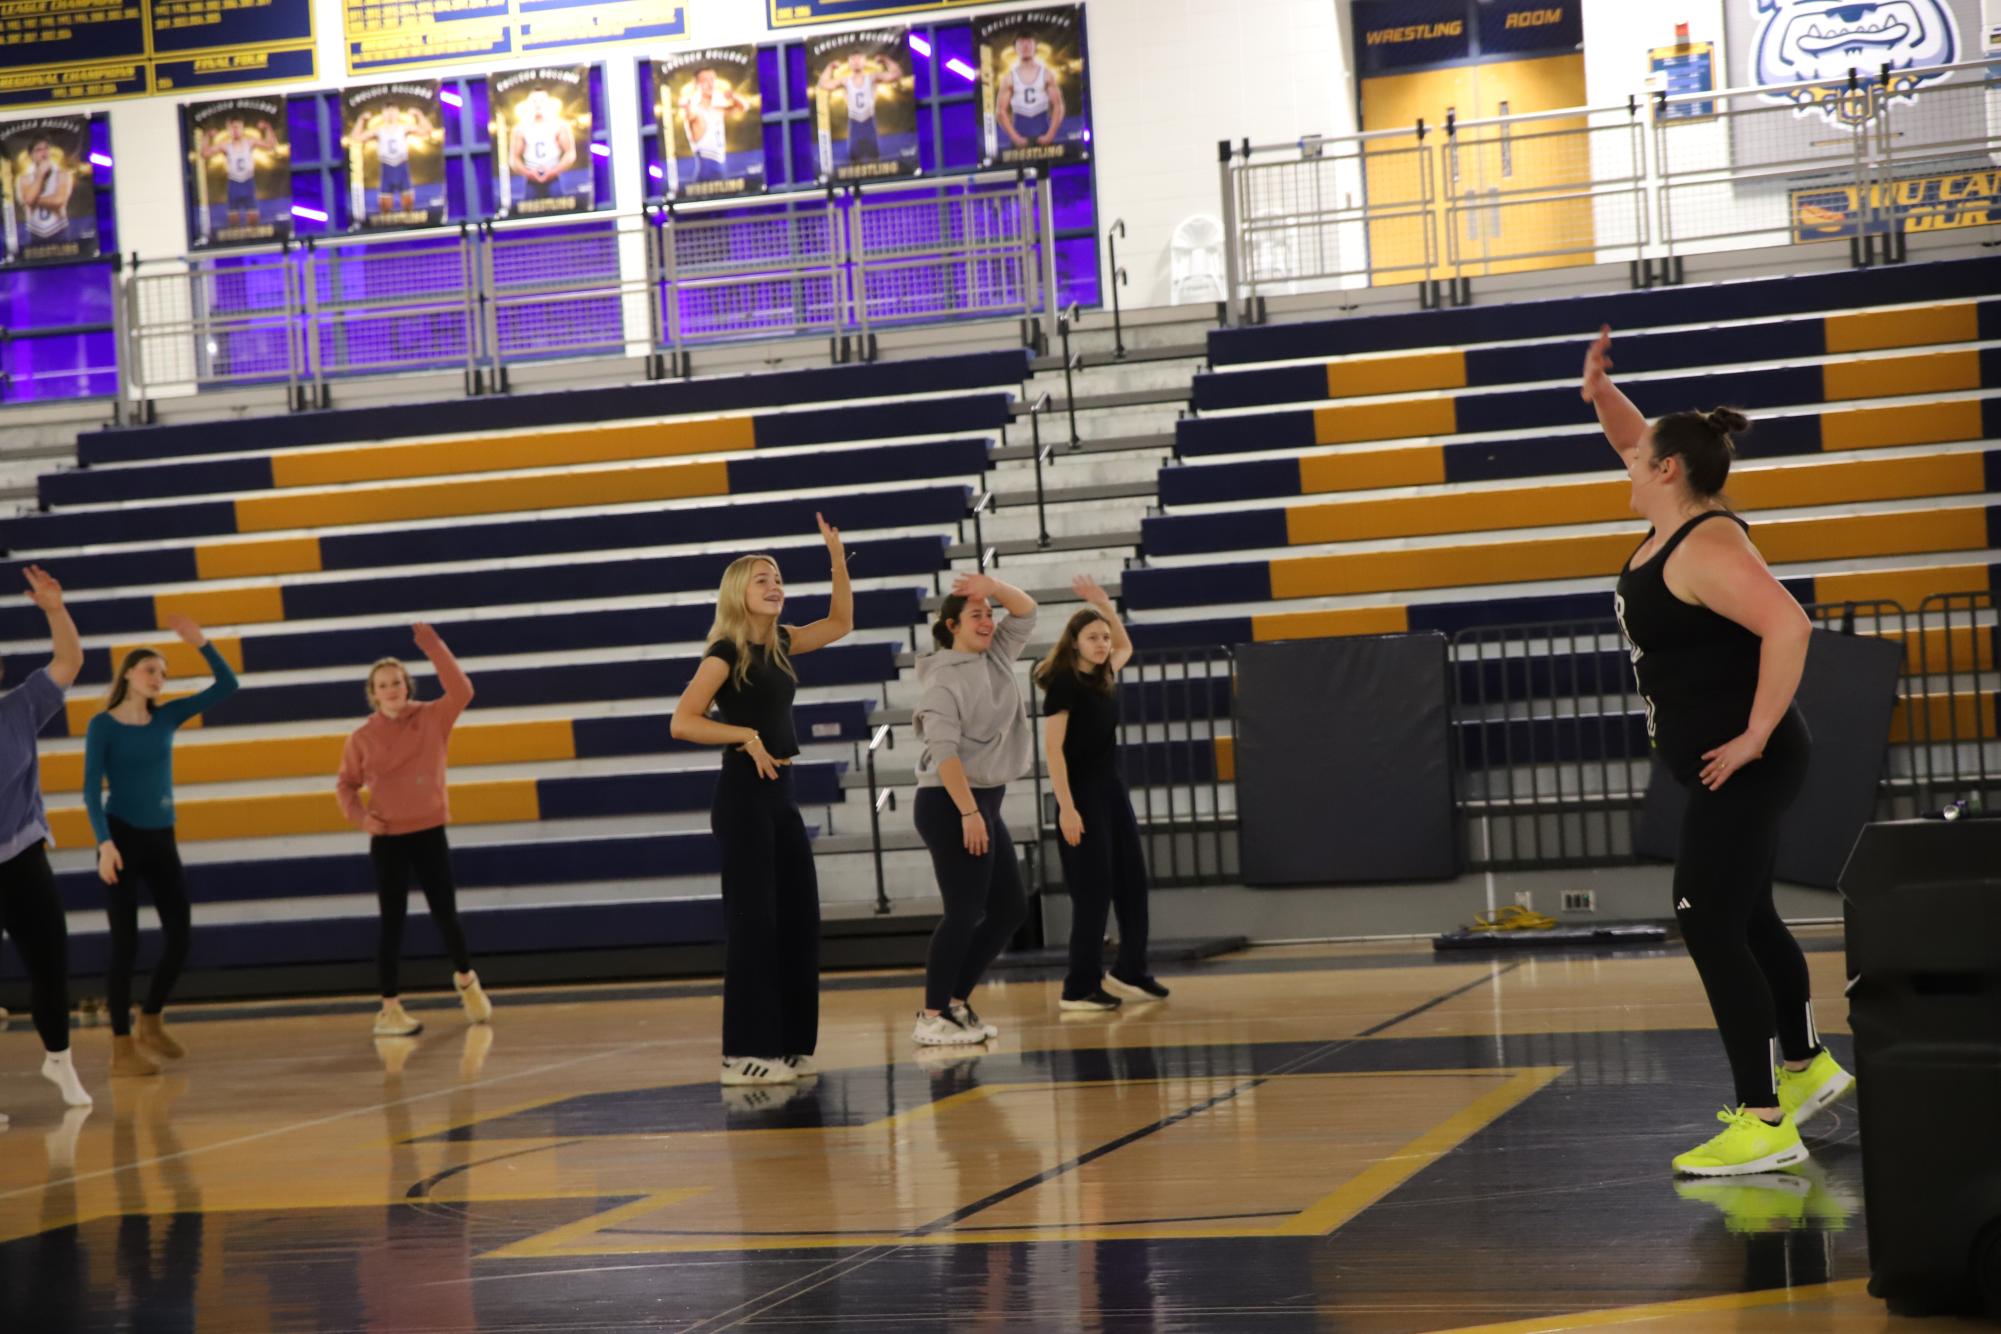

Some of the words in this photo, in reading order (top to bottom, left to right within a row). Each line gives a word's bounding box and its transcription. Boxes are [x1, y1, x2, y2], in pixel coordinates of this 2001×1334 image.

[1366, 20, 1464, 45] WRESTLING
[1504, 8, 1563, 29] ROOM
[855, 92, 865, 109] C
[1024, 88, 1036, 104] C
